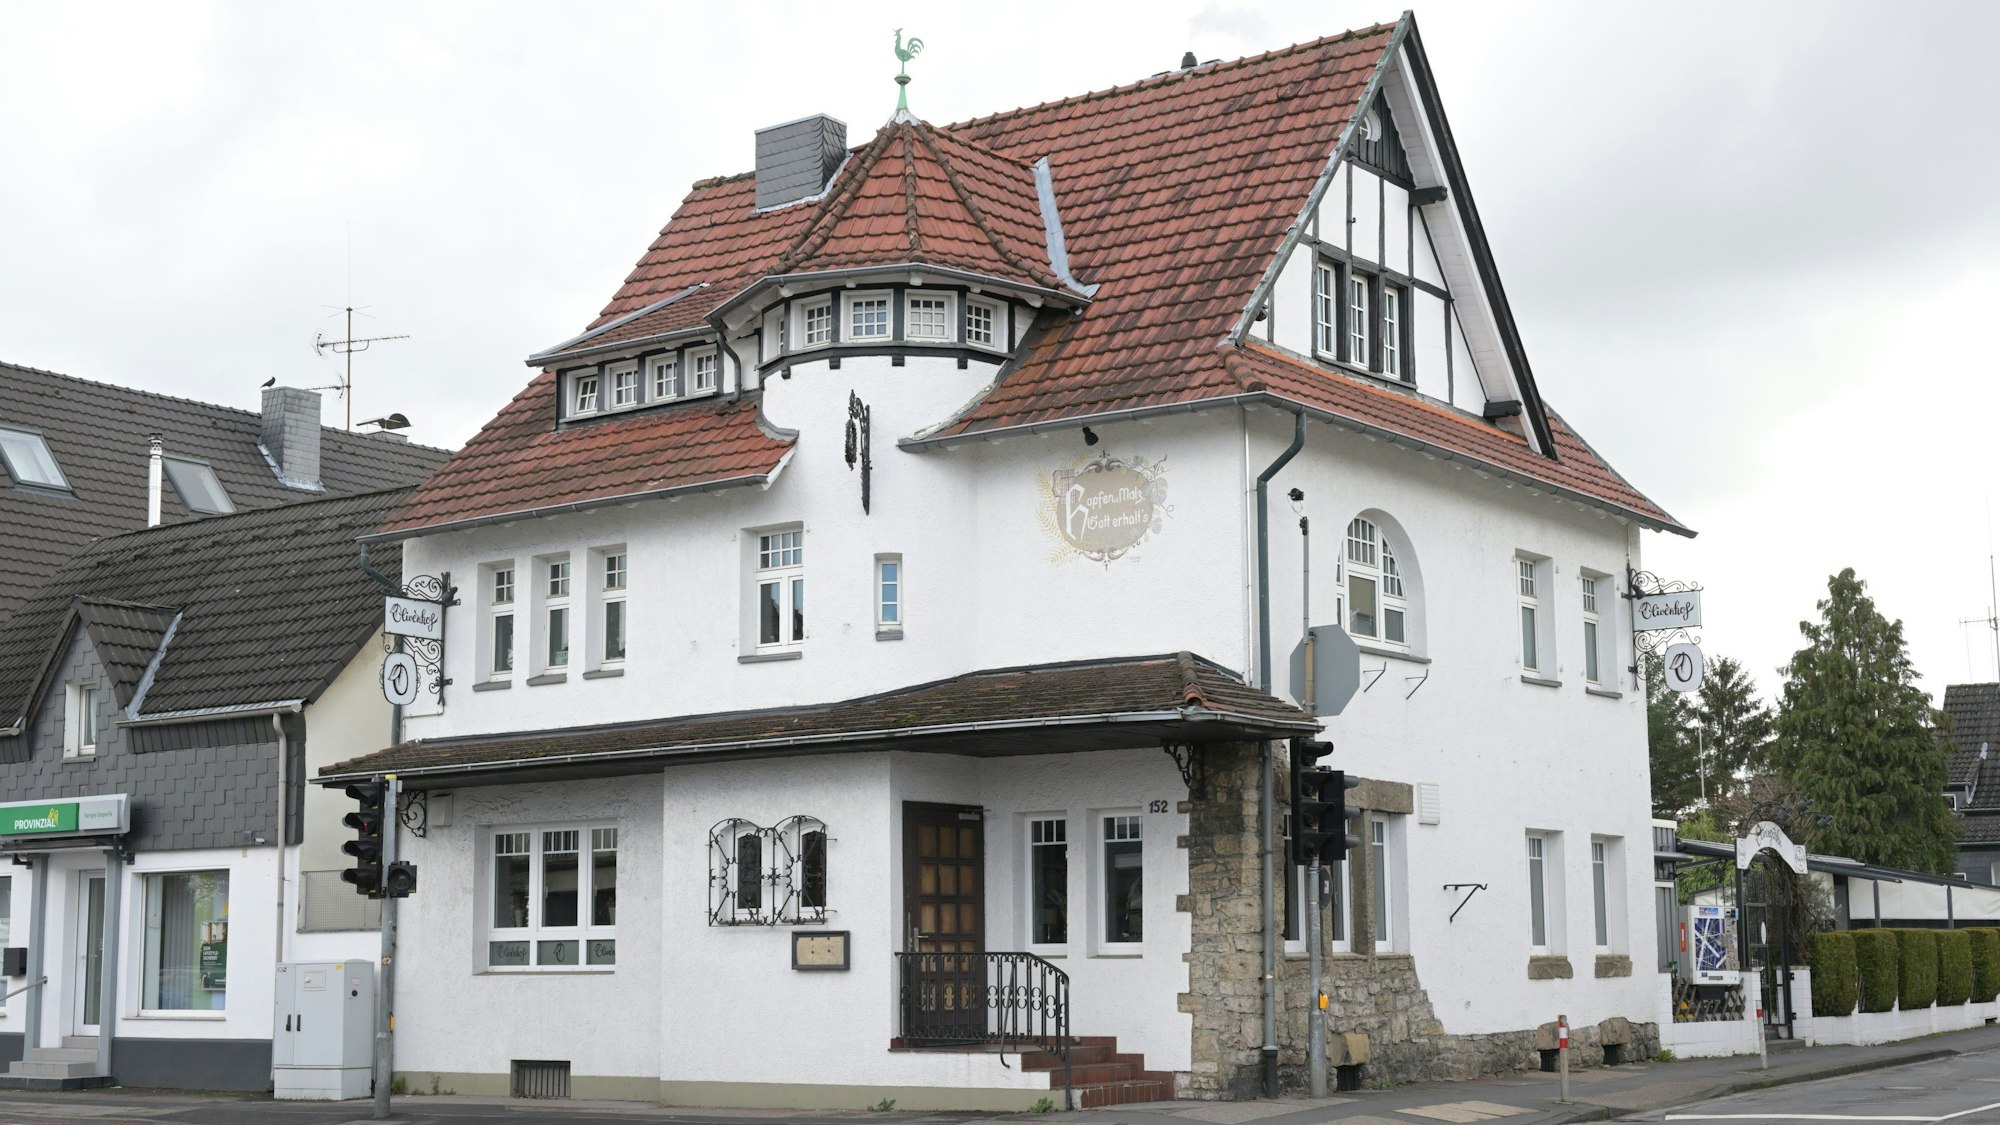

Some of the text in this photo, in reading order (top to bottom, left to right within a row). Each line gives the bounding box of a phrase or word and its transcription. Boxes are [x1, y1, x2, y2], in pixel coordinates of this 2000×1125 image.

[1087, 513, 1110, 530] Gott
[1149, 800, 1168, 814] 152
[14, 818, 56, 830] PROVINZIAL
